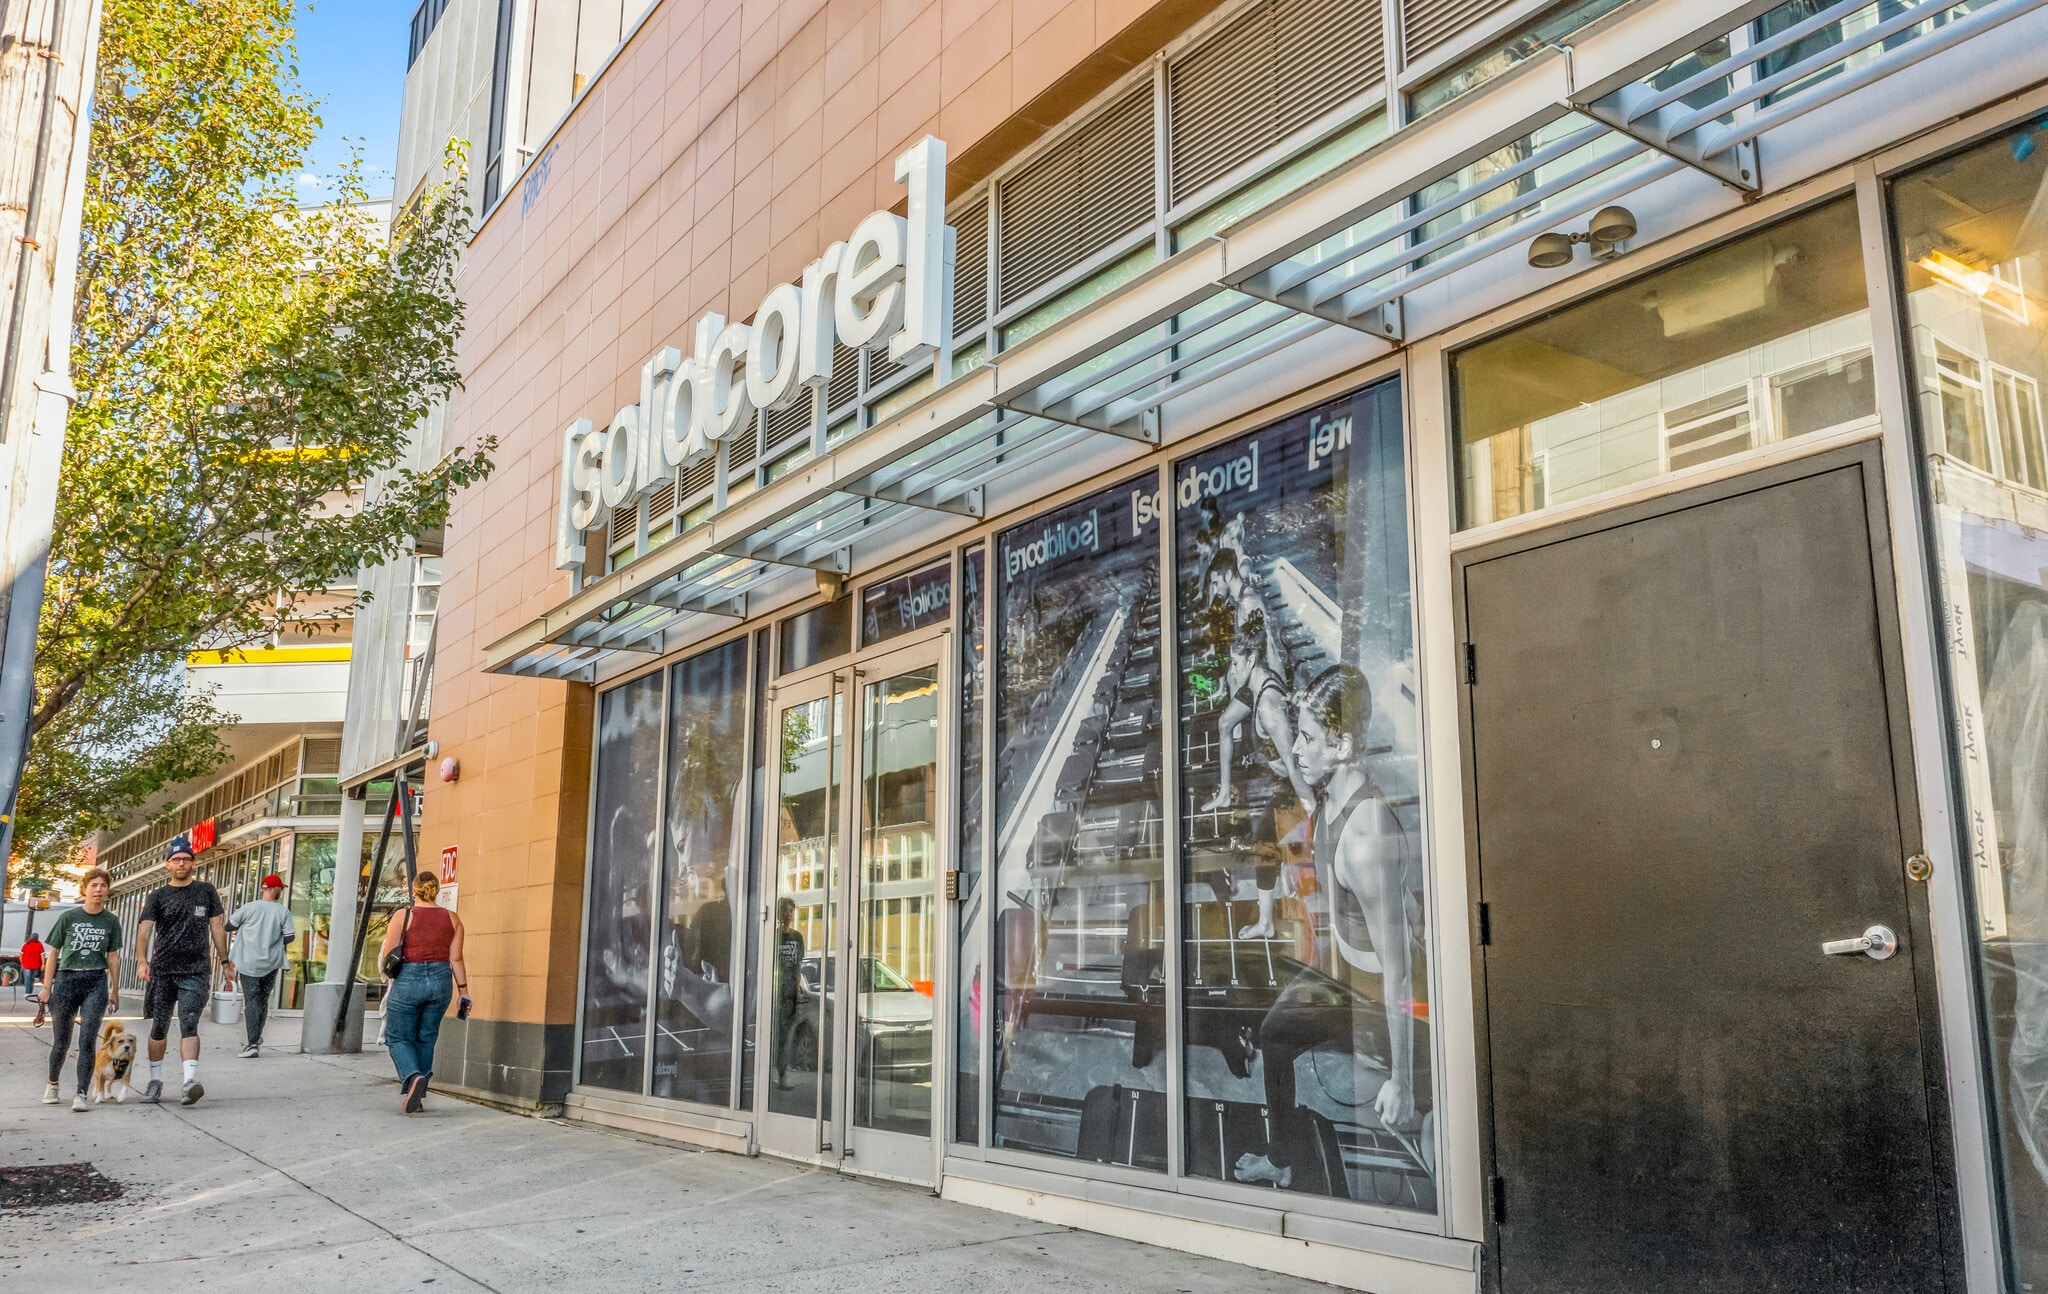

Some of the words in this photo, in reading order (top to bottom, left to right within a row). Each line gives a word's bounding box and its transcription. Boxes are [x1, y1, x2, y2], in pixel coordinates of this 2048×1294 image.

[1132, 440, 1258, 537] [soidcore]
[441, 850, 457, 880] FDC
[72, 922, 106, 935] Green
[72, 932, 105, 942] New
